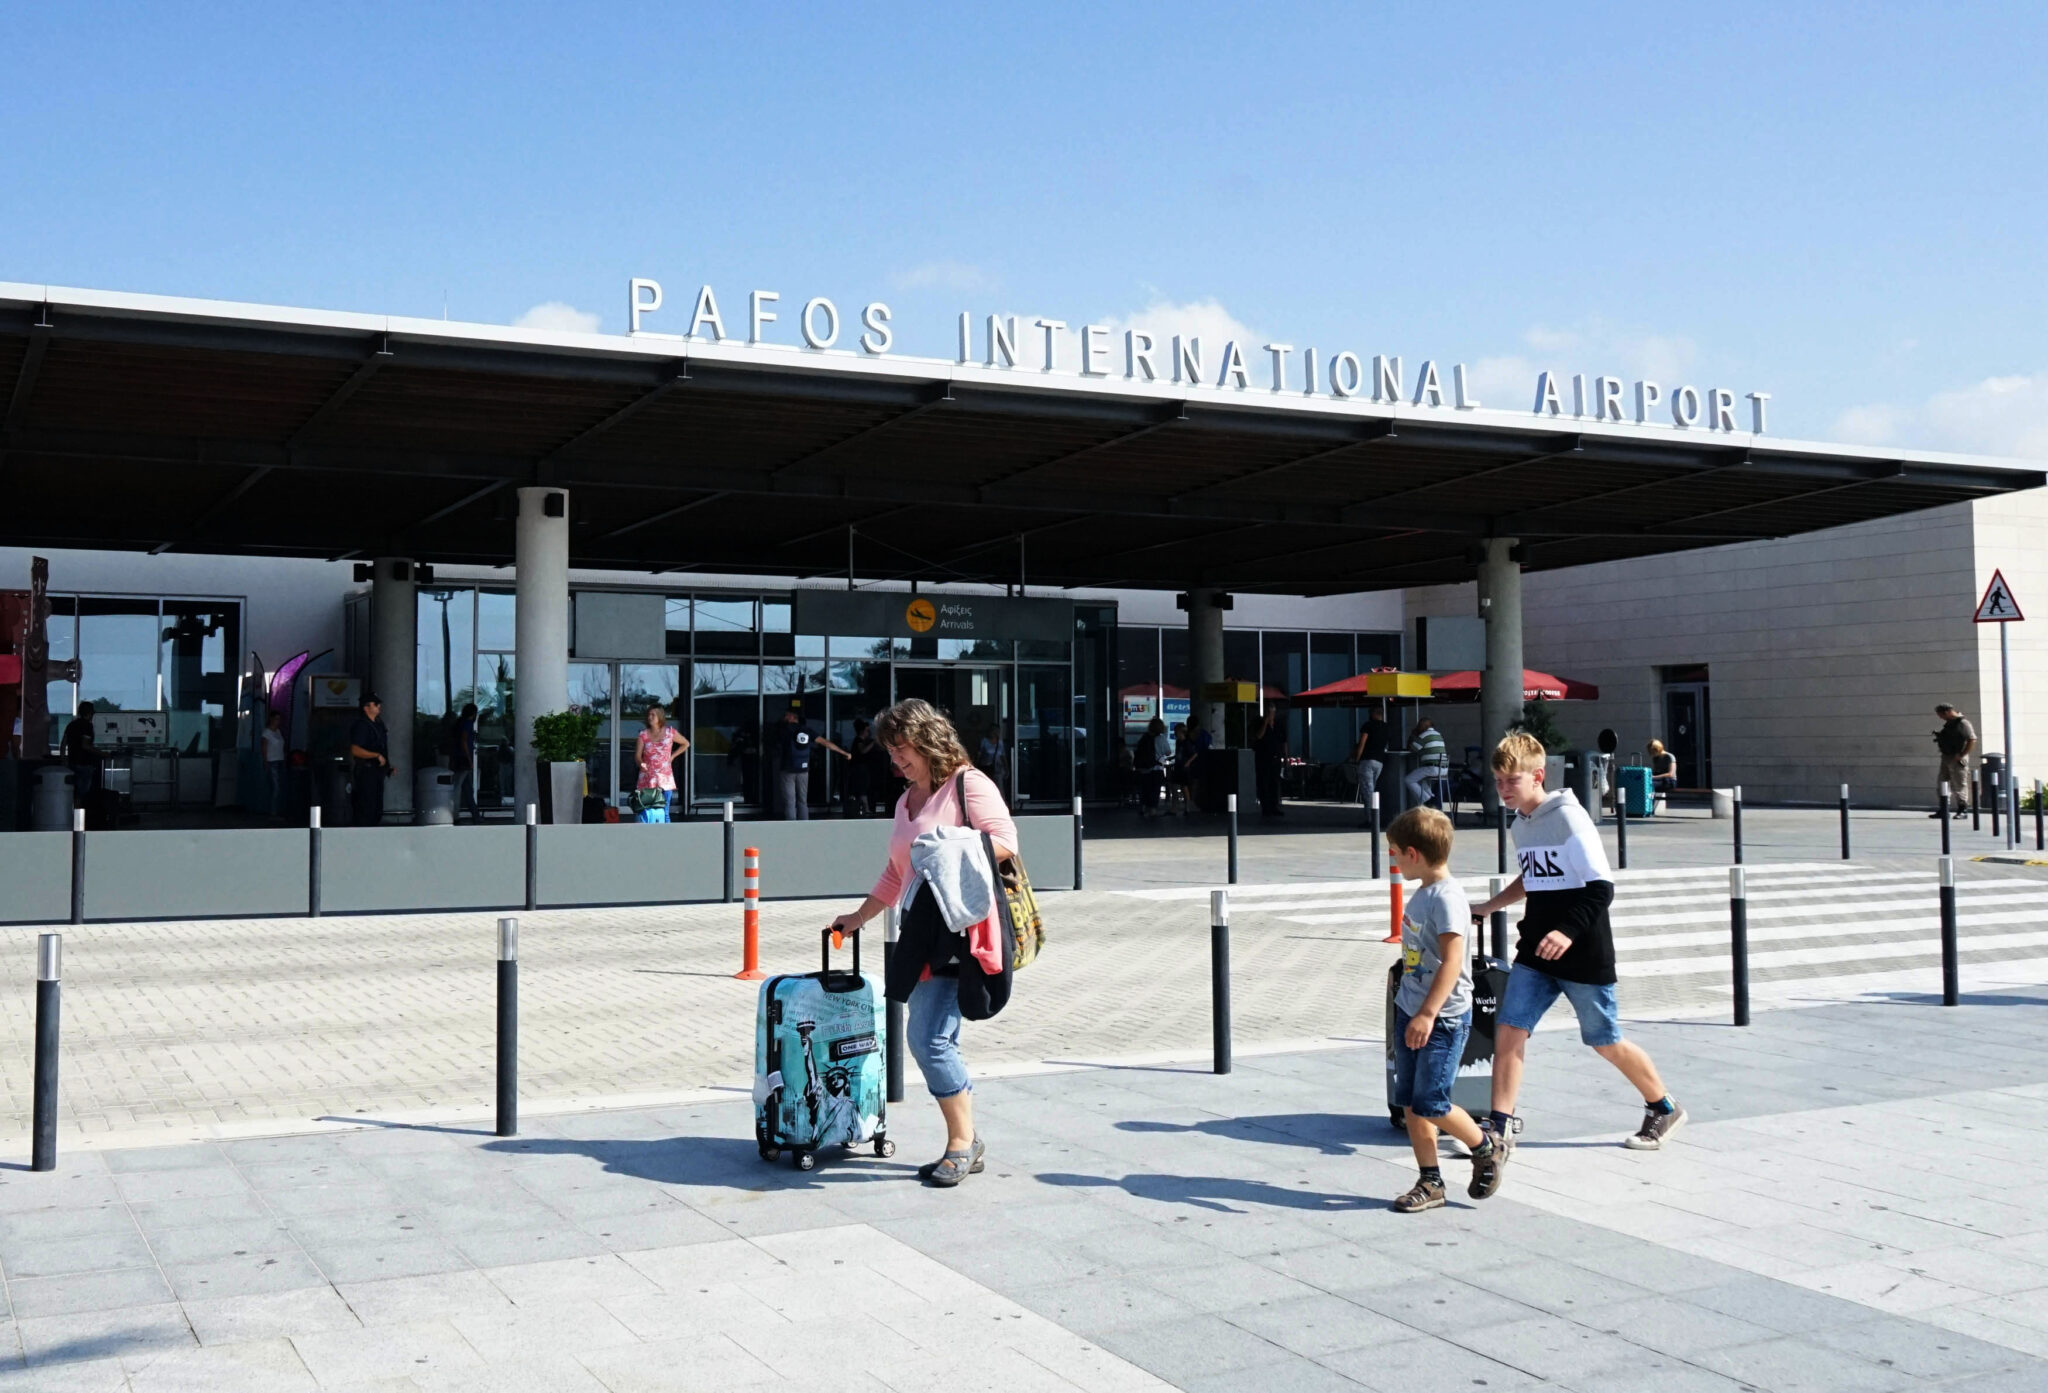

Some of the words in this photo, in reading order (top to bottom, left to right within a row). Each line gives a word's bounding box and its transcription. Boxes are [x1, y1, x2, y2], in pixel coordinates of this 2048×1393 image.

[629, 277, 892, 353] PAFOS
[958, 311, 1480, 408] INTERNATIONAL
[1533, 370, 1771, 434] AIRPORT
[940, 604, 972, 616] Αφίξεις
[940, 619, 974, 629] Arrivals
[842, 997, 860, 1008] YORK
[1475, 996, 1497, 1005] World
[842, 1043, 857, 1052] ONE
